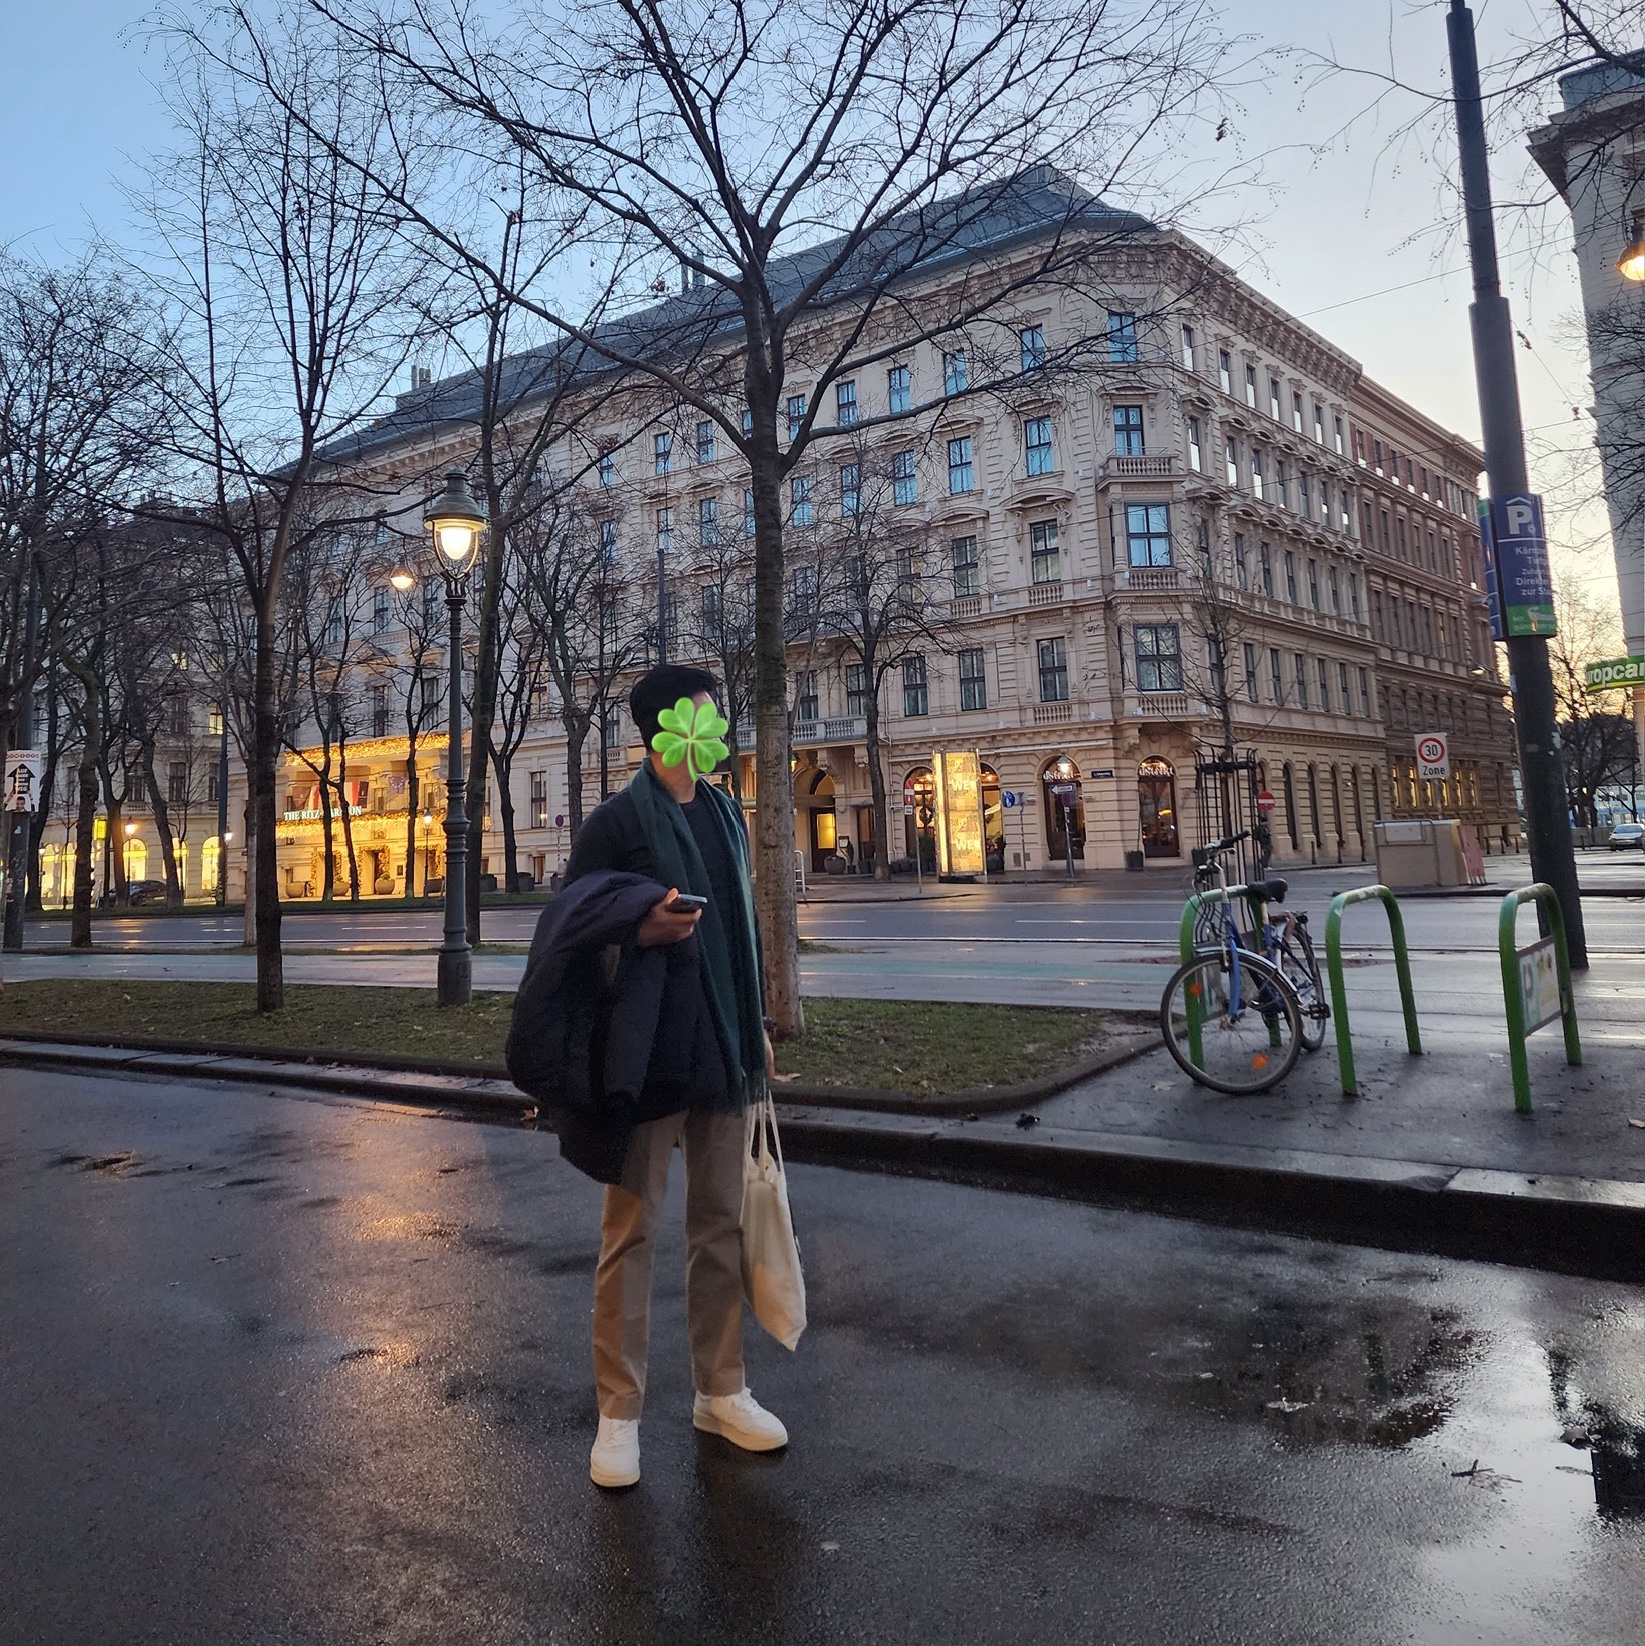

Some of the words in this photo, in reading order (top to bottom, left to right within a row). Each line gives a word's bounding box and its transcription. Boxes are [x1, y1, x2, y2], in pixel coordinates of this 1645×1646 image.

[1507, 505, 1533, 534] P
[1425, 744, 1438, 756] 30
[1422, 765, 1445, 776] Zone
[284, 811, 299, 821] THE
